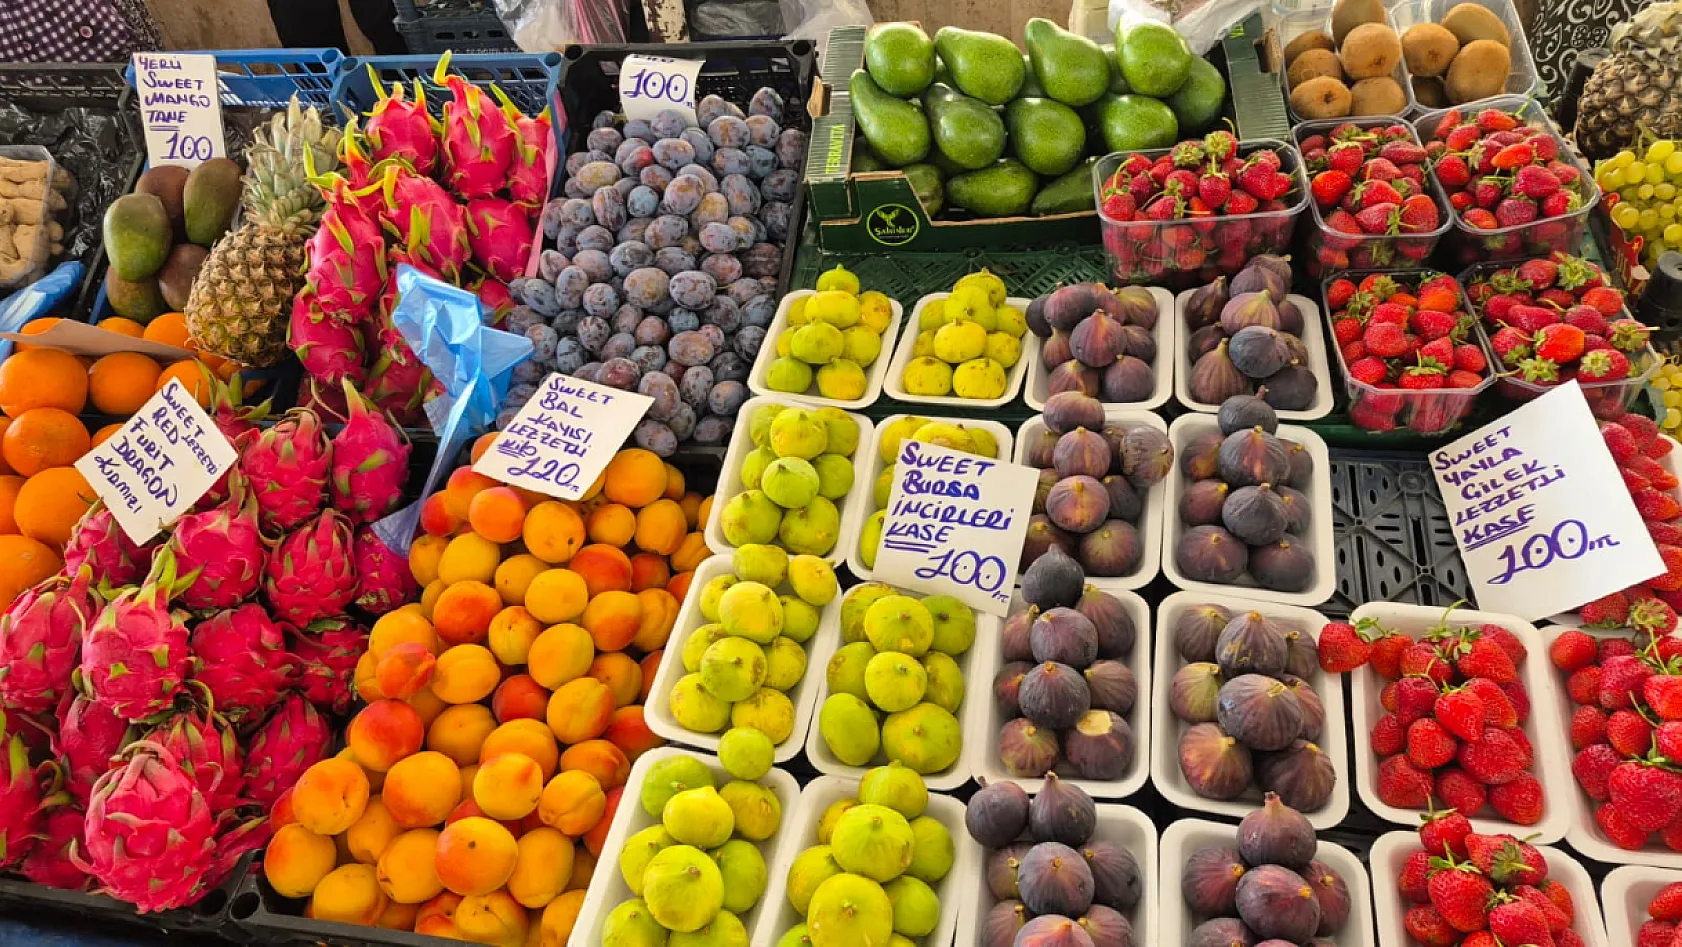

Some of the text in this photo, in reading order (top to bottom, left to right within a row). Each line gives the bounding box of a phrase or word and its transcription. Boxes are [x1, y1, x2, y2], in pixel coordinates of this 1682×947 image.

[143, 71, 205, 91] SWEET
[623, 68, 688, 103] 100
[145, 92, 211, 108] MANGO
[146, 110, 187, 124] TANE
[160, 131, 213, 161] 100
[539, 391, 583, 418] BAL
[549, 377, 614, 405] SWEET
[152, 406, 178, 446] RED
[161, 382, 205, 439] SWEET
[901, 441, 996, 477] SWEET
[1435, 425, 1512, 471] SWEET
[110, 435, 178, 507] DRAGON
[1442, 446, 1524, 488] YAYLA
[901, 469, 980, 501] BURSA
[885, 521, 955, 543] KASE
[1463, 503, 1537, 546] KASE
[1486, 519, 1590, 585] 100
[914, 548, 1007, 592] 100
